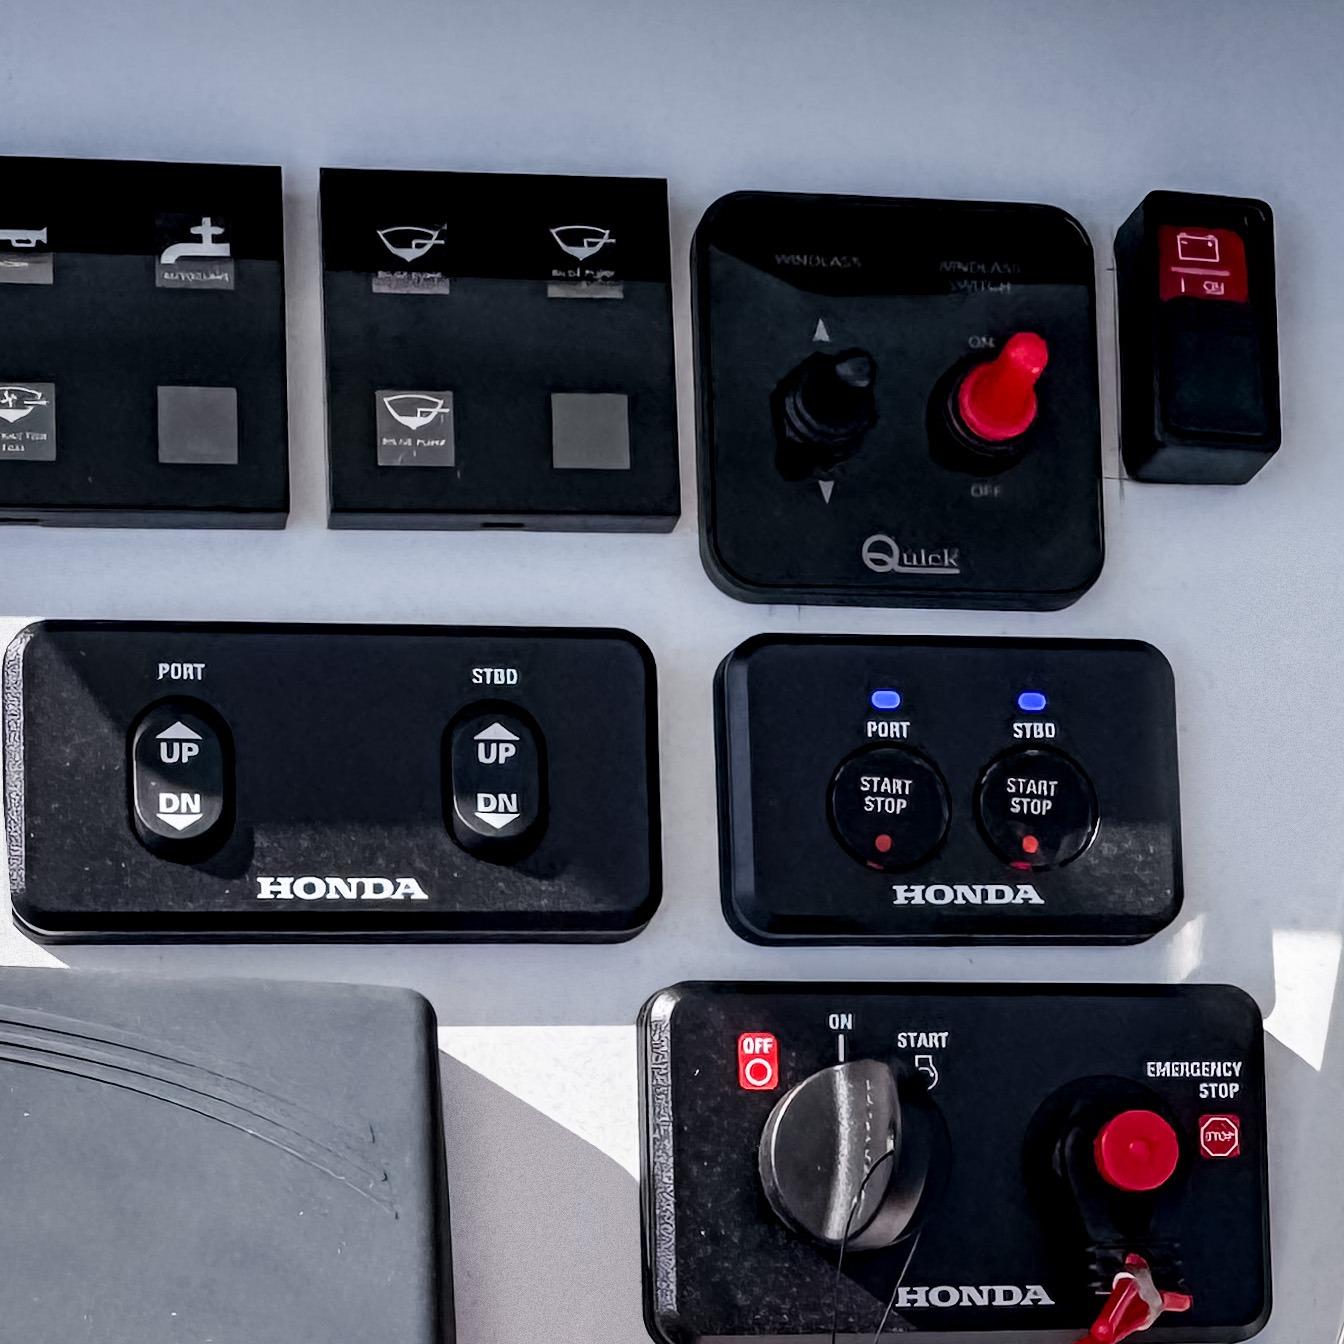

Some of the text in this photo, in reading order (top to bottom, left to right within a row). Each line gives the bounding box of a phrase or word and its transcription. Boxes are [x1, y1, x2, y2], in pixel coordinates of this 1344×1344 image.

[861, 534, 961, 574] Quick
[157, 662, 206, 681] PORT
[471, 667, 518, 685] STBD
[866, 720, 911, 739] PORT
[1012, 722, 1056, 739] STBD
[159, 741, 200, 764] UP
[477, 742, 516, 764] UP
[860, 776, 913, 795] START
[1006, 777, 1059, 797] START
[158, 792, 201, 812] DN
[476, 793, 518, 813] DN
[863, 795, 907, 815] STOP
[1010, 797, 1054, 816] STOP
[256, 876, 429, 900] HONDA
[892, 884, 1045, 905] HONDA
[828, 1013, 853, 1030] ON
[742, 1036, 774, 1055] OFF
[897, 1031, 949, 1049] START
[1146, 1061, 1243, 1078] EMERGENCY
[1199, 1082, 1240, 1099] STOP
[895, 1285, 1056, 1307] HONDA
